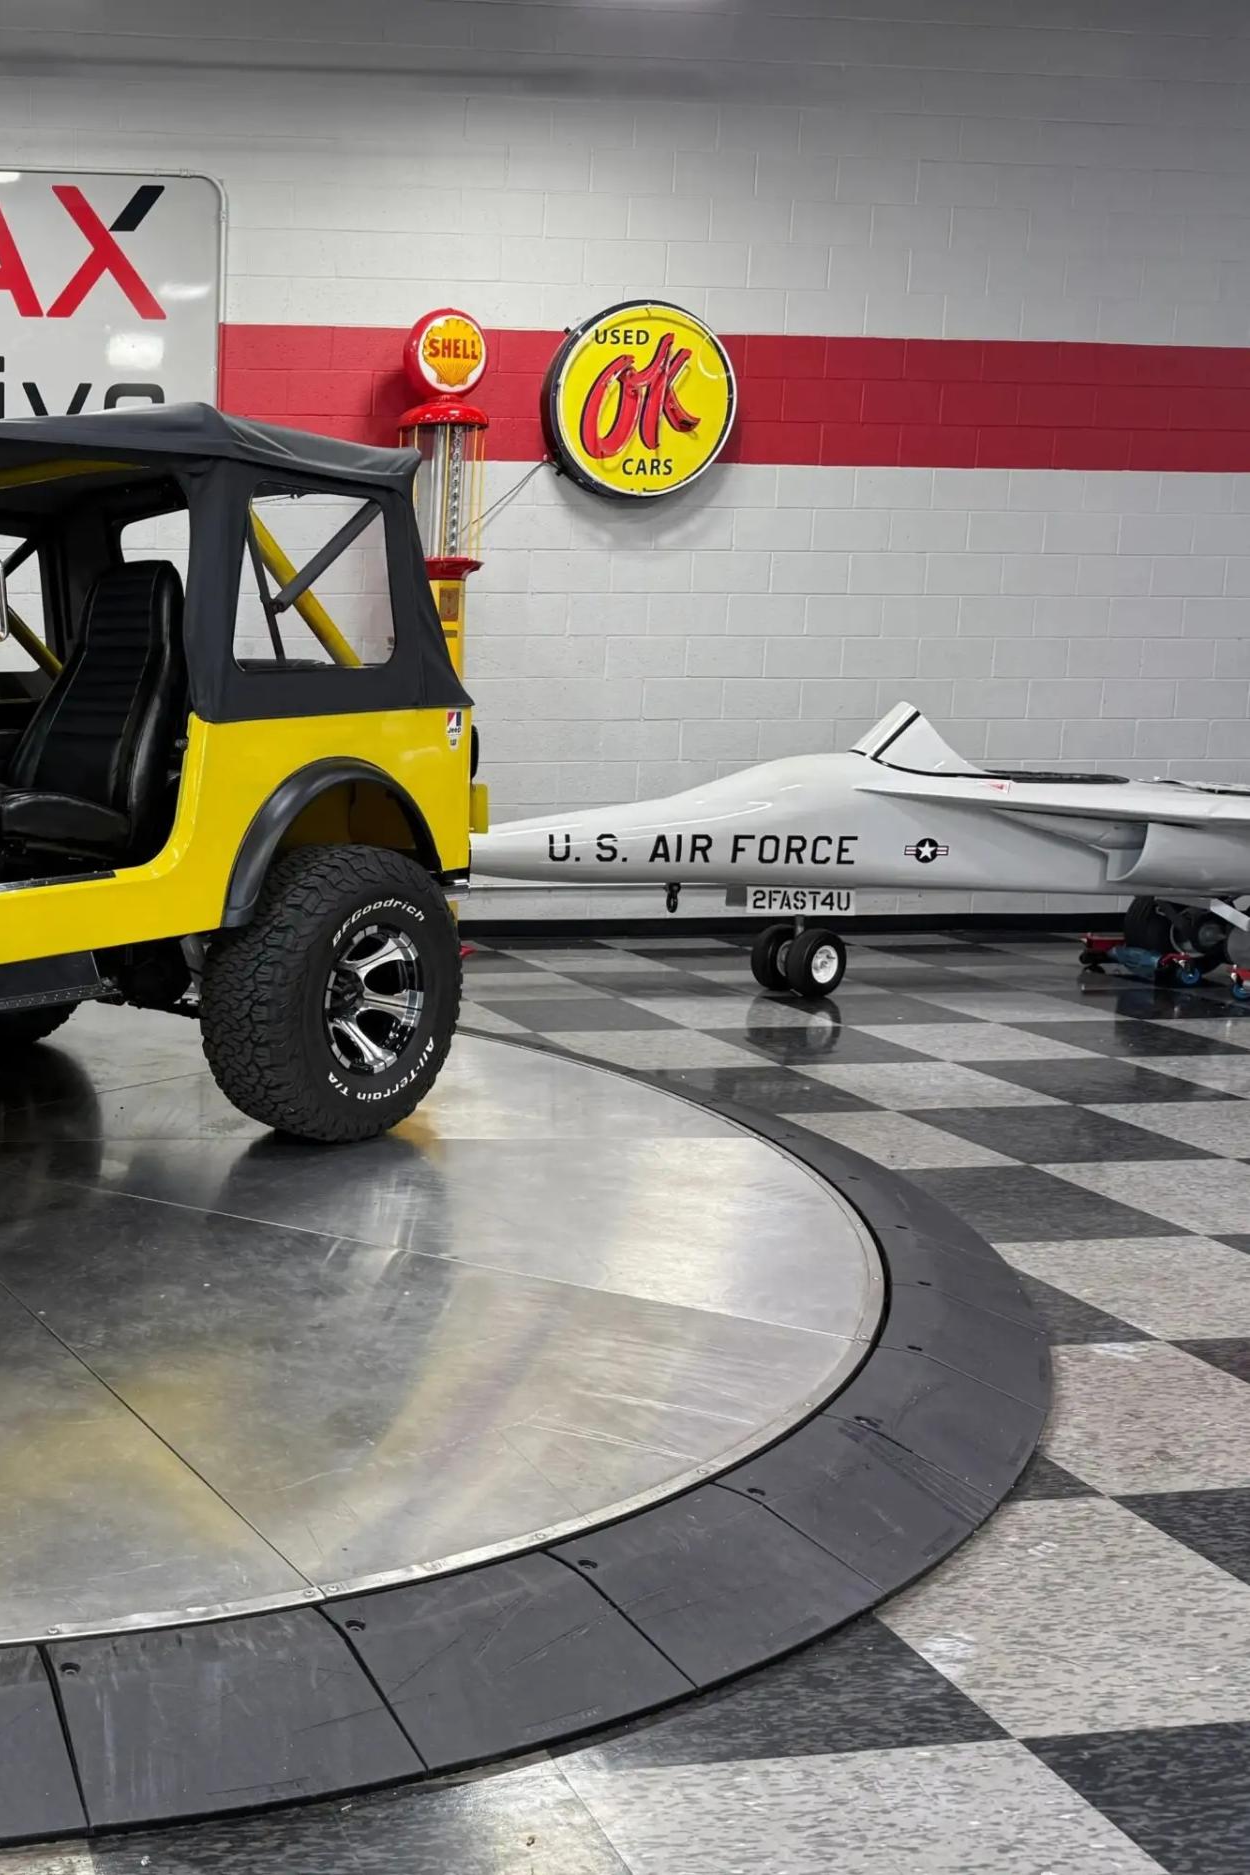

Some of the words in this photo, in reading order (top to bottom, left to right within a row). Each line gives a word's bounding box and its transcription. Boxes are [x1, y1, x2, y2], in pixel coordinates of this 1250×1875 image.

[428, 338, 478, 360] SHELL
[594, 329, 650, 345] USED
[579, 333, 701, 459] OK
[622, 458, 673, 475] CARS
[548, 834, 581, 862] U.
[595, 833, 628, 862] S.
[649, 834, 713, 863] AIR
[730, 835, 858, 865] FORCE
[752, 890, 851, 911] 2FAST4U
[333, 898, 425, 948] BFGoodrich
[357, 1036, 434, 1102] All-Terrain
[328, 1071, 350, 1097] T/A
